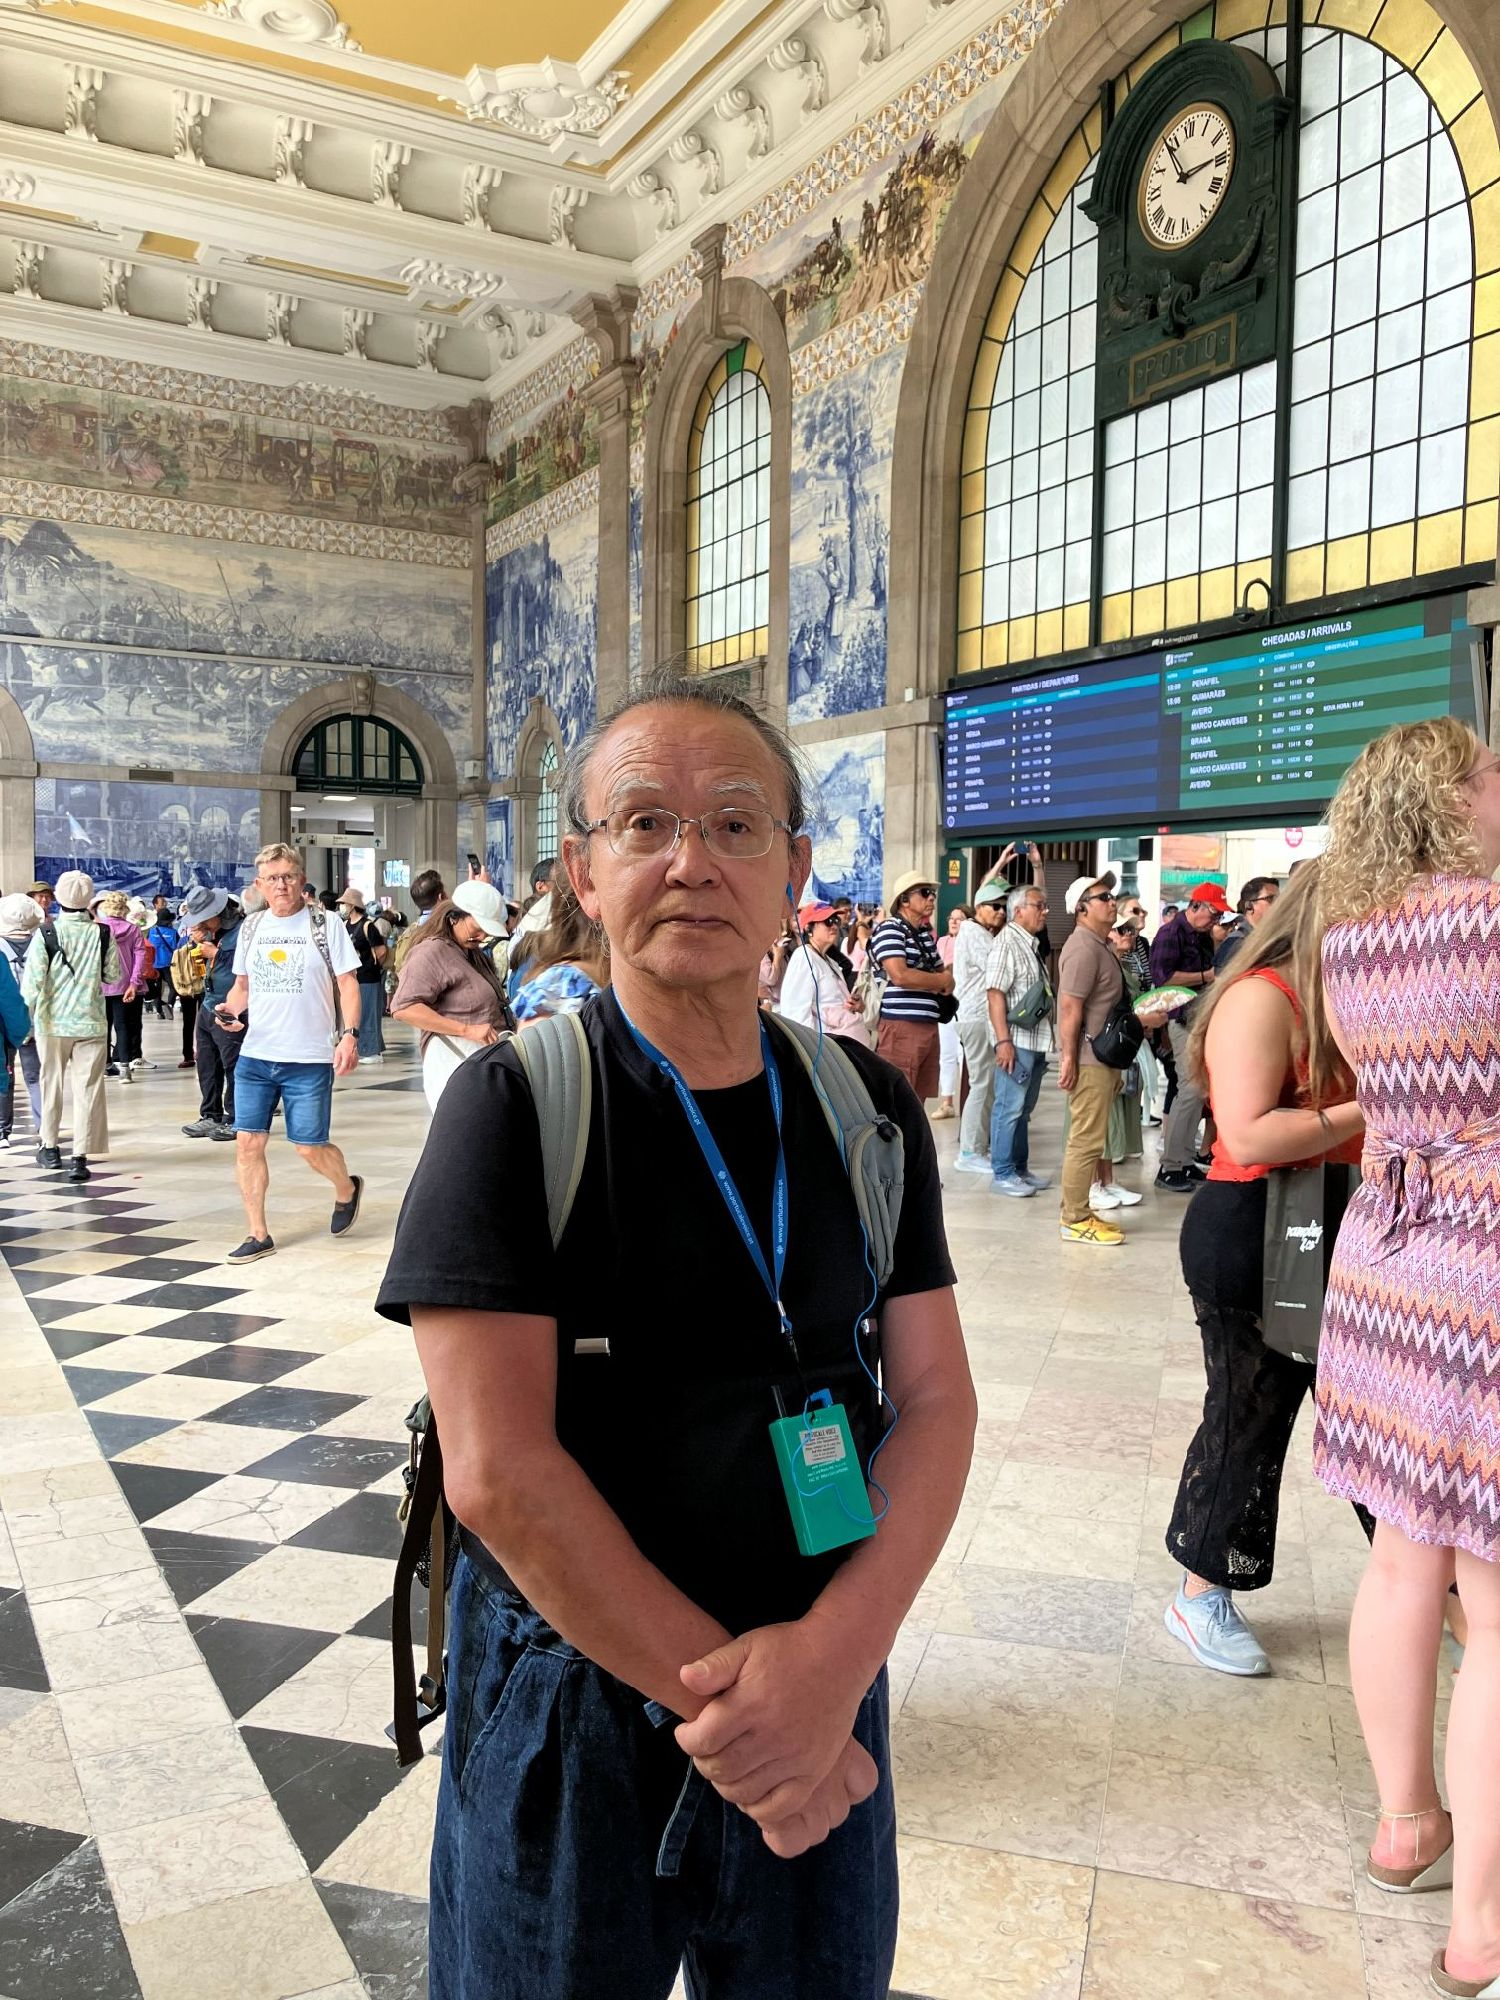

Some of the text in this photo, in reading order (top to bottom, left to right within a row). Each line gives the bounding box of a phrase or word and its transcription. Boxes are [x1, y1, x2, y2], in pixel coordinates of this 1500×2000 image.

[1145, 331, 1217, 386] PORTO
[1261, 630, 1306, 647] CHEGADAS
[1311, 621, 1353, 637] ARRIVALS
[1192, 677, 1220, 688] PENAFIEL
[1191, 689, 1226, 702] GUIMARÃES
[1191, 706, 1213, 717] AVEIRO
[1191, 720, 1212, 731] MARCO
[1213, 716, 1248, 728] CANAVESES
[1190, 736, 1212, 746] BRAGA
[1190, 749, 1218, 760] PENAFIEL
[1190, 765, 1211, 775] MARCO
[1211, 761, 1248, 772] CANAVESES
[1190, 780, 1212, 790] AVEIRO
